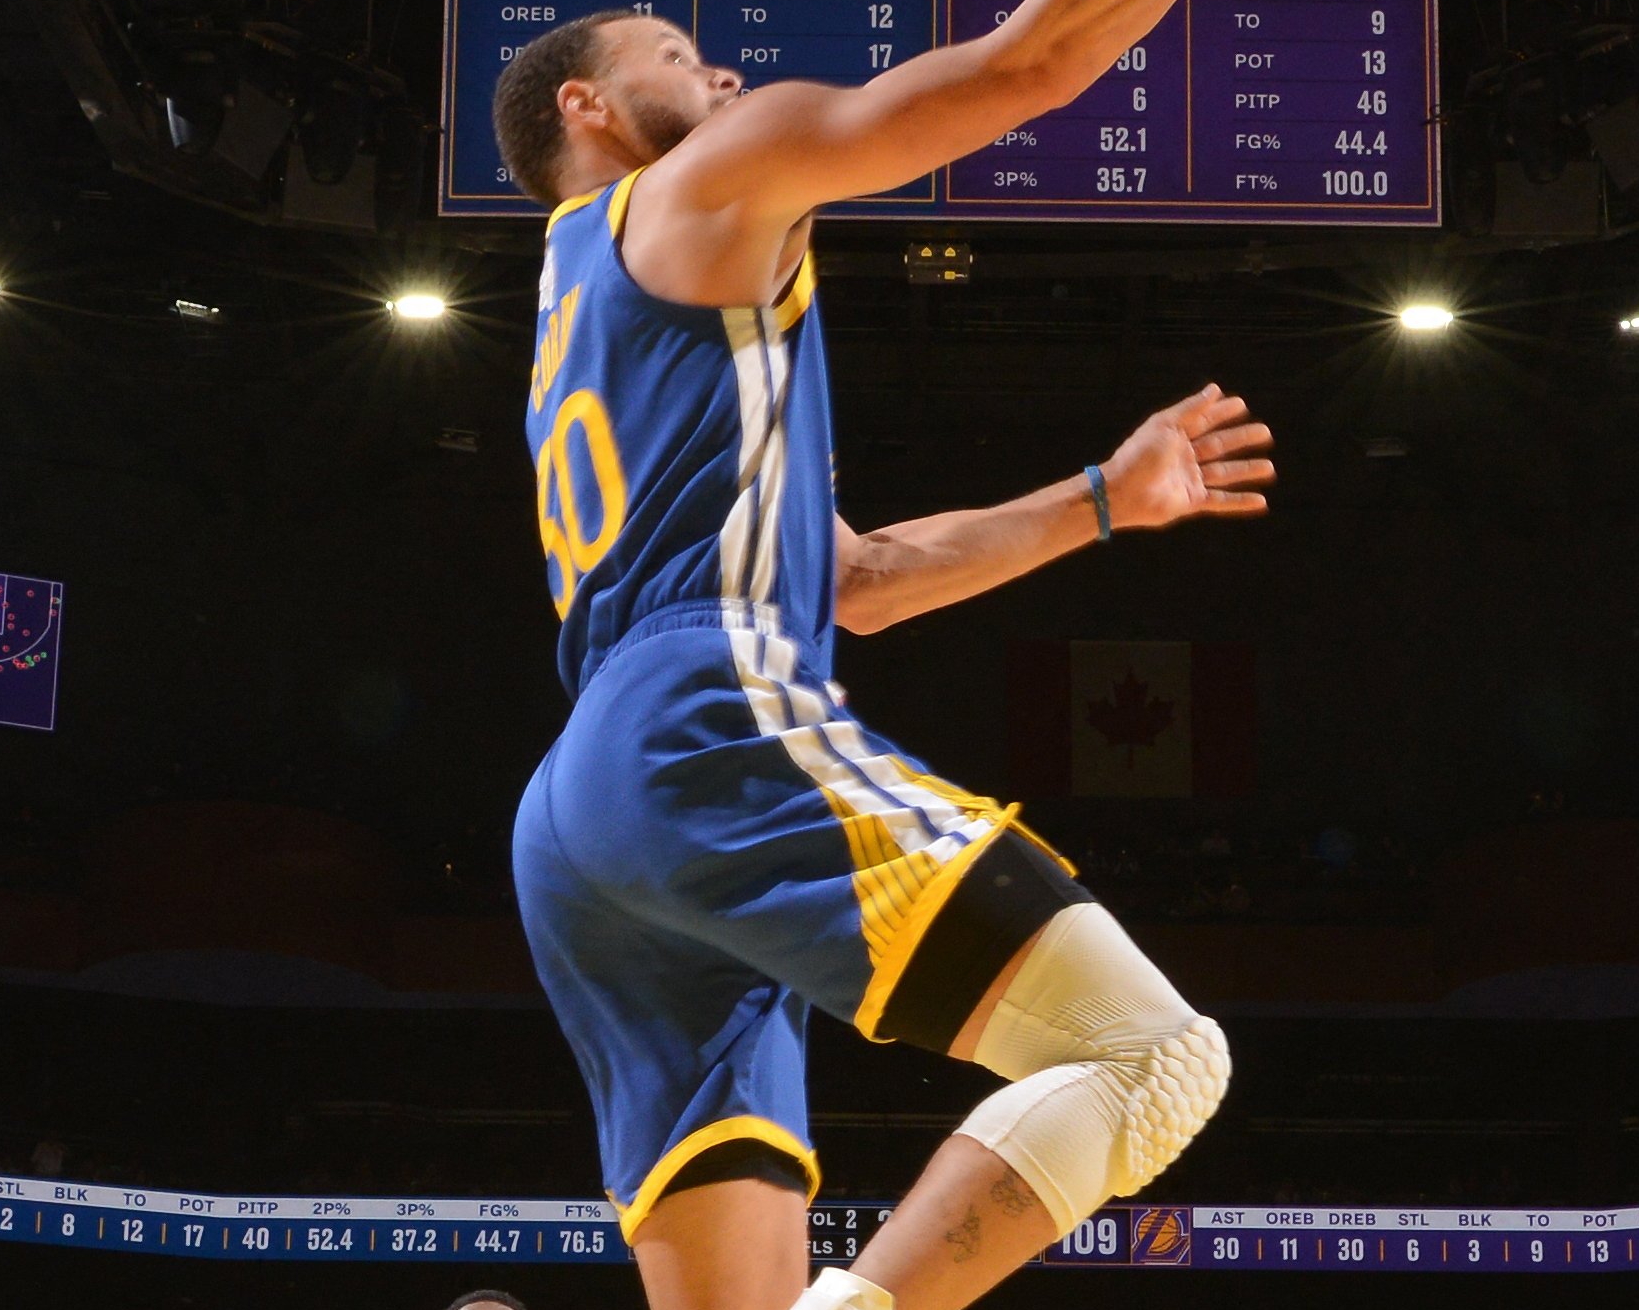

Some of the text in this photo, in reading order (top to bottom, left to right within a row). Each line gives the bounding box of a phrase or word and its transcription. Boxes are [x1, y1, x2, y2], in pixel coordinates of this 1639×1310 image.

[501, 7, 556, 22] OREB
[742, 4, 893, 29] TO 12
[1235, 11, 1386, 35] TO 9
[741, 44, 893, 68] POT 17
[1117, 47, 1146, 71] 30
[1235, 51, 1386, 75] POT 13
[1132, 87, 1147, 111] 6
[1235, 91, 1387, 115] PITP 46
[1100, 128, 1147, 152] 52.1
[1235, 131, 1388, 156] FG% 44.4
[994, 168, 1147, 193] 3P% 35.7
[1236, 171, 1388, 196] FT% 100.0
[54, 1186, 89, 1203] BLK
[123, 1192, 146, 1207] TO
[179, 1197, 215, 1214] POT
[237, 1200, 280, 1216] PITP
[312, 1201, 352, 1217] 2P%
[396, 1202, 435, 1218] 3P%
[479, 1203, 520, 1219] FG%
[564, 1203, 602, 1220] FT%
[0, 1207, 13, 1231] 2
[61, 1213, 75, 1237] 8
[121, 1219, 144, 1244] 12
[183, 1223, 205, 1249] 17
[241, 1226, 270, 1251] 40
[307, 1227, 353, 1252] 52.4
[391, 1228, 437, 1253] 37.2
[474, 1228, 521, 1253] 44.7
[560, 1229, 605, 1254] 76.5
[846, 1209, 858, 1229] 2
[1211, 1212, 1245, 1226] AST
[1266, 1212, 1315, 1226] OREB
[1329, 1212, 1377, 1227] DREB
[1398, 1213, 1430, 1228] STL
[1459, 1214, 1492, 1228] BLK
[1526, 1214, 1550, 1228] TO
[1583, 1214, 1618, 1228] POT
[846, 1237, 858, 1258] 3
[1062, 1218, 1117, 1255] 109
[1213, 1237, 1240, 1260] 30
[1280, 1238, 1298, 1260] 11
[1338, 1238, 1365, 1261] 30
[1406, 1239, 1420, 1262] 6
[1468, 1239, 1480, 1262] 3
[1530, 1239, 1543, 1262] 9
[1587, 1239, 1609, 1263] 13
